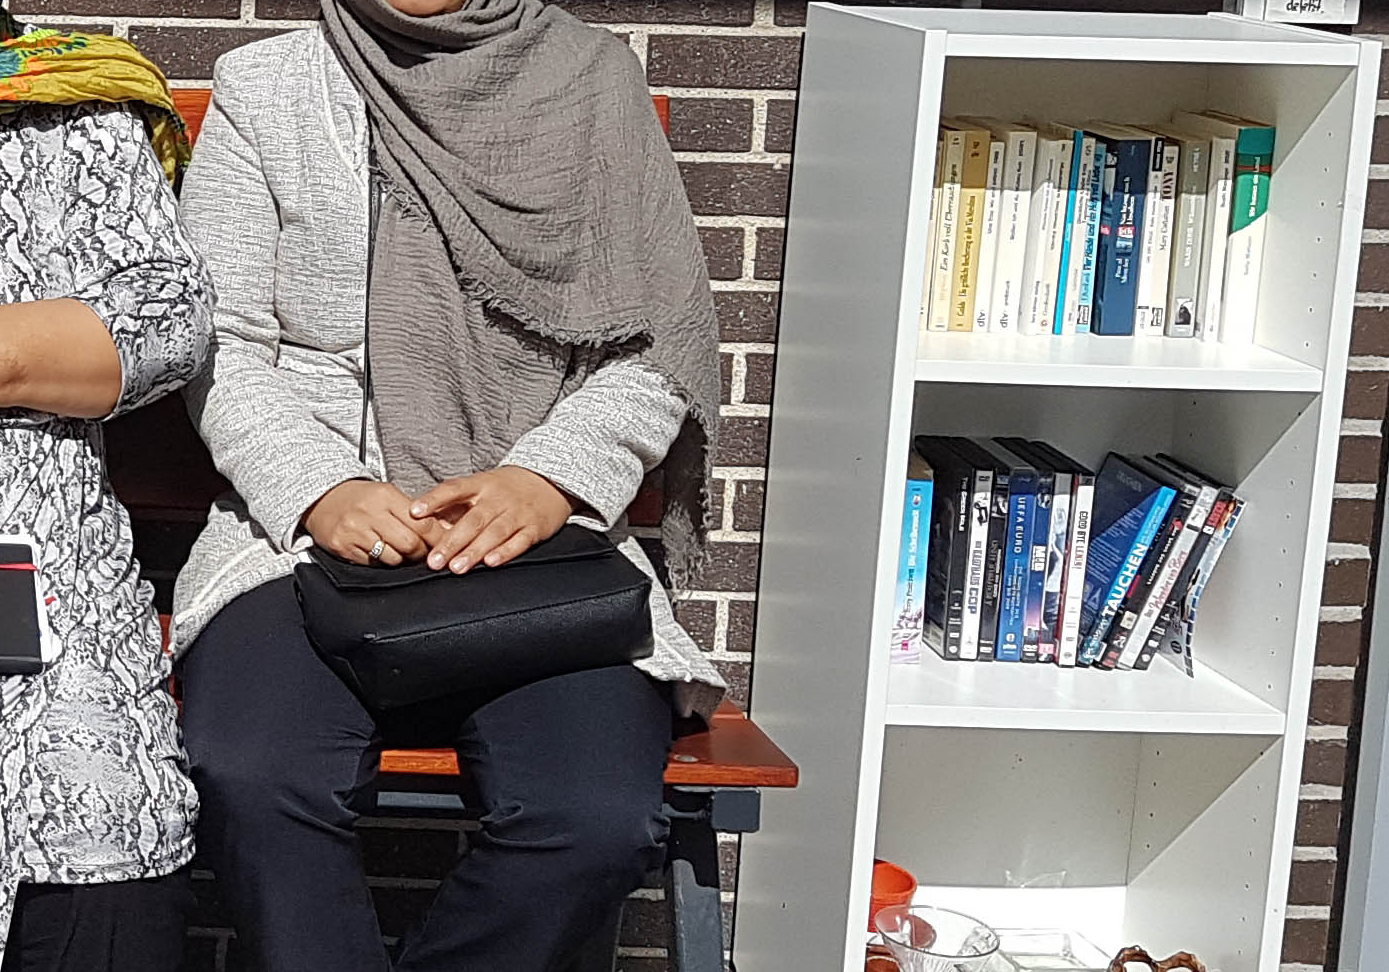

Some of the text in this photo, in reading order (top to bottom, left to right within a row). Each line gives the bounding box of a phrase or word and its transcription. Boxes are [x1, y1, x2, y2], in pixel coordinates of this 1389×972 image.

[1160, 171, 1174, 201] TONY
[977, 311, 985, 328] dtv
[1000, 312, 1009, 329] dtv
[1016, 496, 1027, 523] UEFA
[1013, 525, 1026, 554] EURO
[1076, 530, 1087, 545] BYE
[1101, 543, 1149, 618] TAUCHEN
[968, 587, 979, 615] COP
